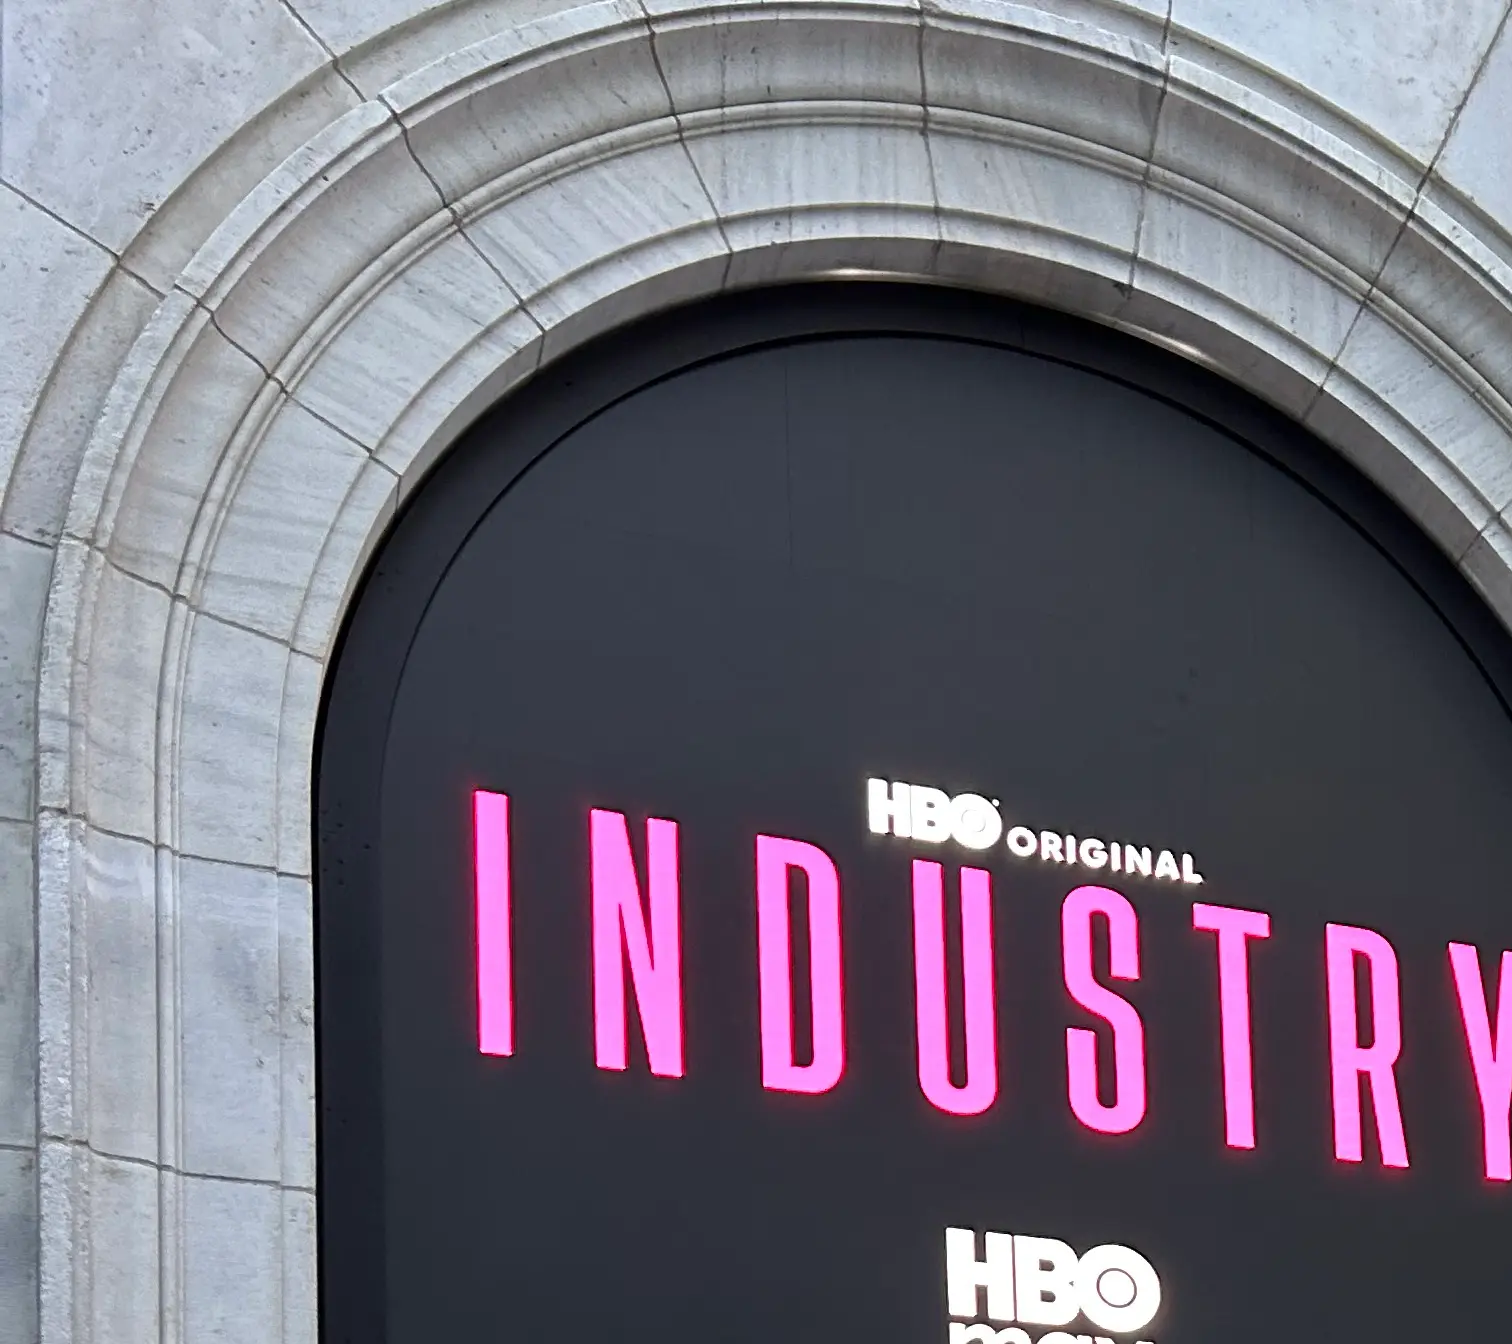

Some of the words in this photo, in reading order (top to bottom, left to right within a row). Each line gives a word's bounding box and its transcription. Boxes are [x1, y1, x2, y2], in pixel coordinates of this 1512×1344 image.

[867, 777, 1002, 850] HBO
[1006, 826, 1203, 884] ORIGINAL
[945, 1227, 1162, 1333] HBO
